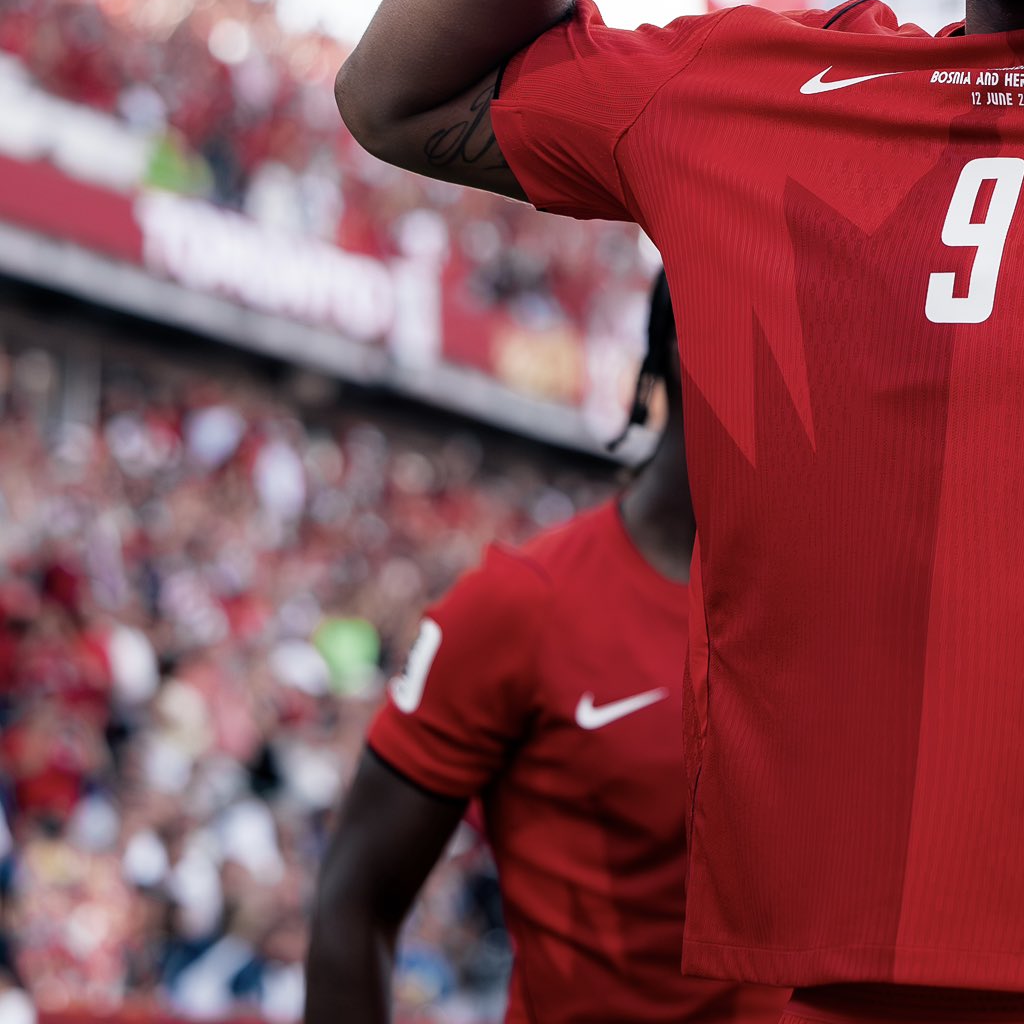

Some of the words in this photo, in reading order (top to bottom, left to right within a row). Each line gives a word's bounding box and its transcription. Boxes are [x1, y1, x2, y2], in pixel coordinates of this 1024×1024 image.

[930, 71, 971, 85] BOSNIA
[976, 72, 999, 86] AND
[971, 91, 982, 105] 12
[986, 92, 1013, 106] JUNE
